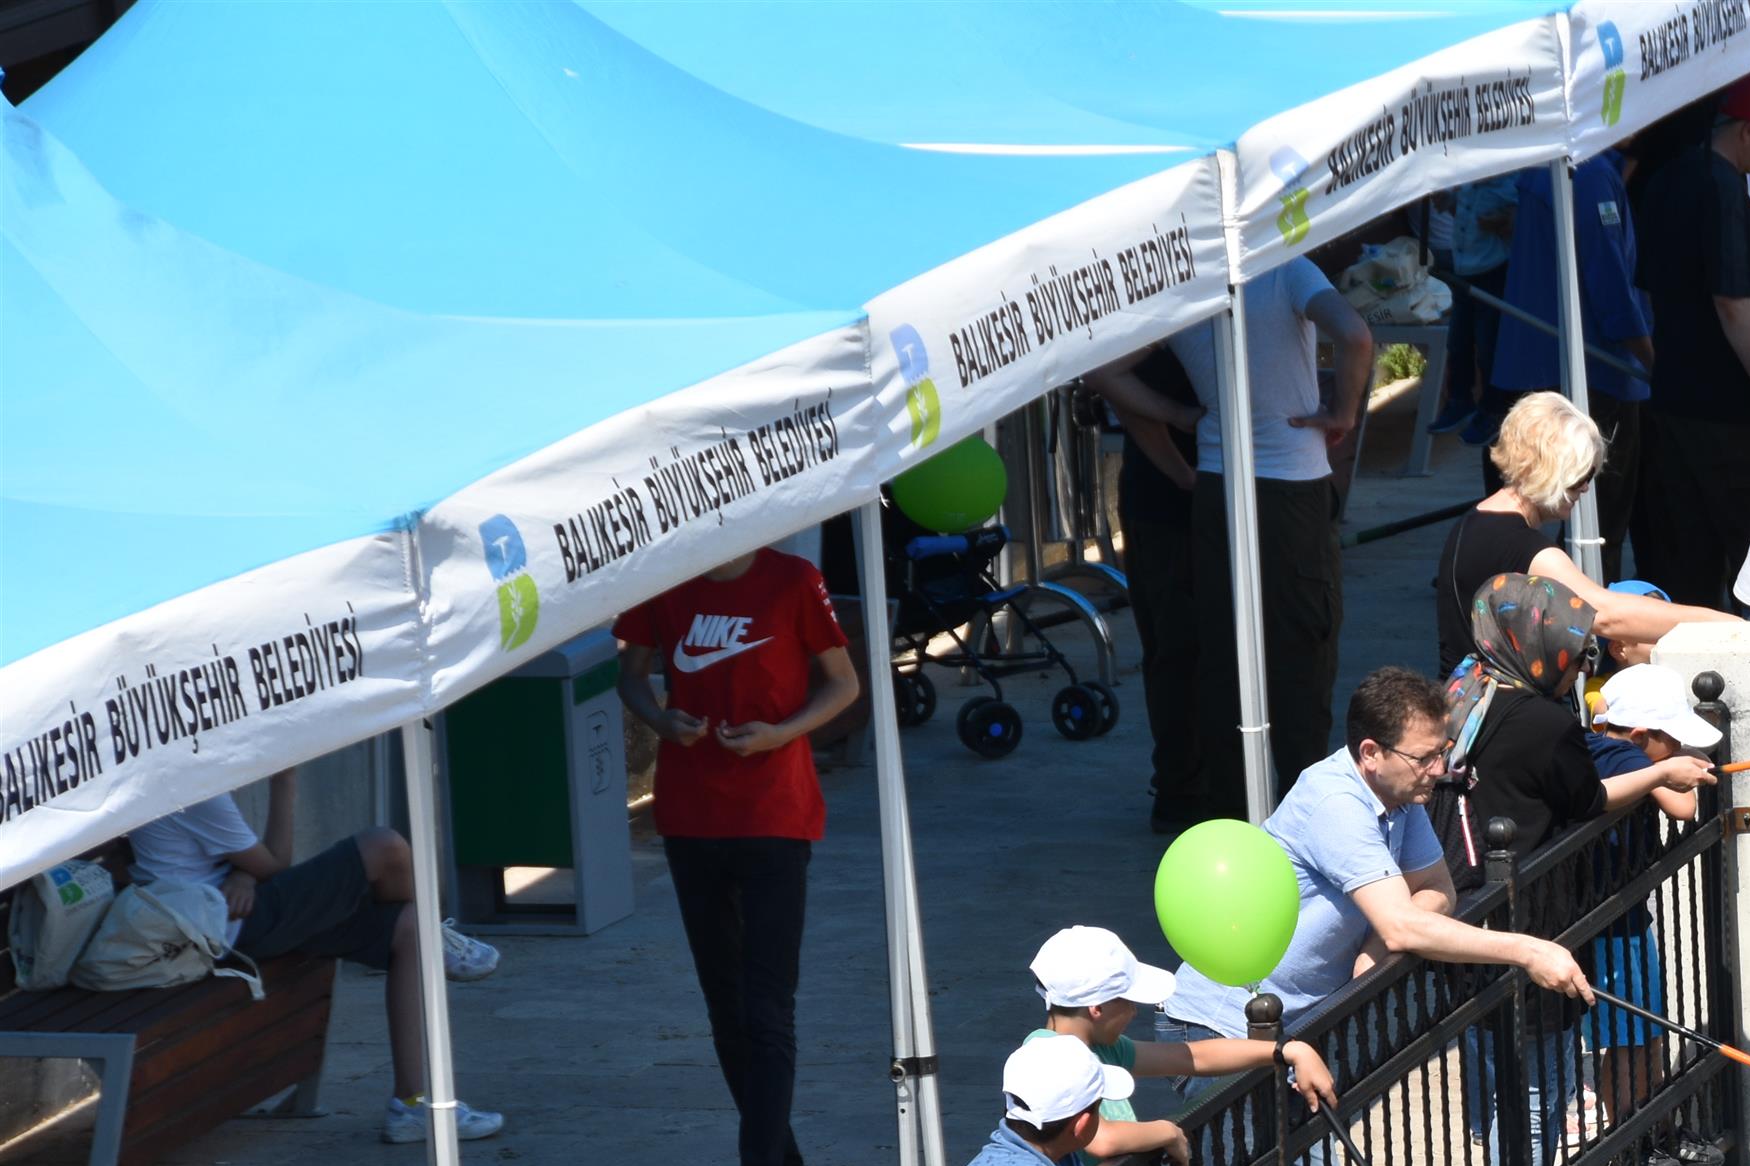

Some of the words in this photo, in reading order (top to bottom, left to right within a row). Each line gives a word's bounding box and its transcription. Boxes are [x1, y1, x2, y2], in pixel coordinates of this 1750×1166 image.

[1639, 4, 1690, 81] BALIKESİR
[1325, 104, 1395, 195] BALIKESİR
[1400, 75, 1471, 156] BÜYÜKŞEHİR
[1475, 64, 1535, 134] BELEDİYESİ
[949, 291, 1031, 388] BALIKESİR
[1025, 249, 1121, 346] BÜYÜKŞEHİR
[1117, 212, 1197, 305] BELEDİYESİ
[553, 477, 653, 584] BALIKESİR
[643, 427, 757, 534] BÜYÜKŞEHİR
[747, 387, 840, 487] BELEDİYESİ
[105, 643, 249, 765] BÜYÜKŞEHİR
[248, 601, 363, 711] BELEDİYESİ
[685, 613, 752, 649] NIKE
